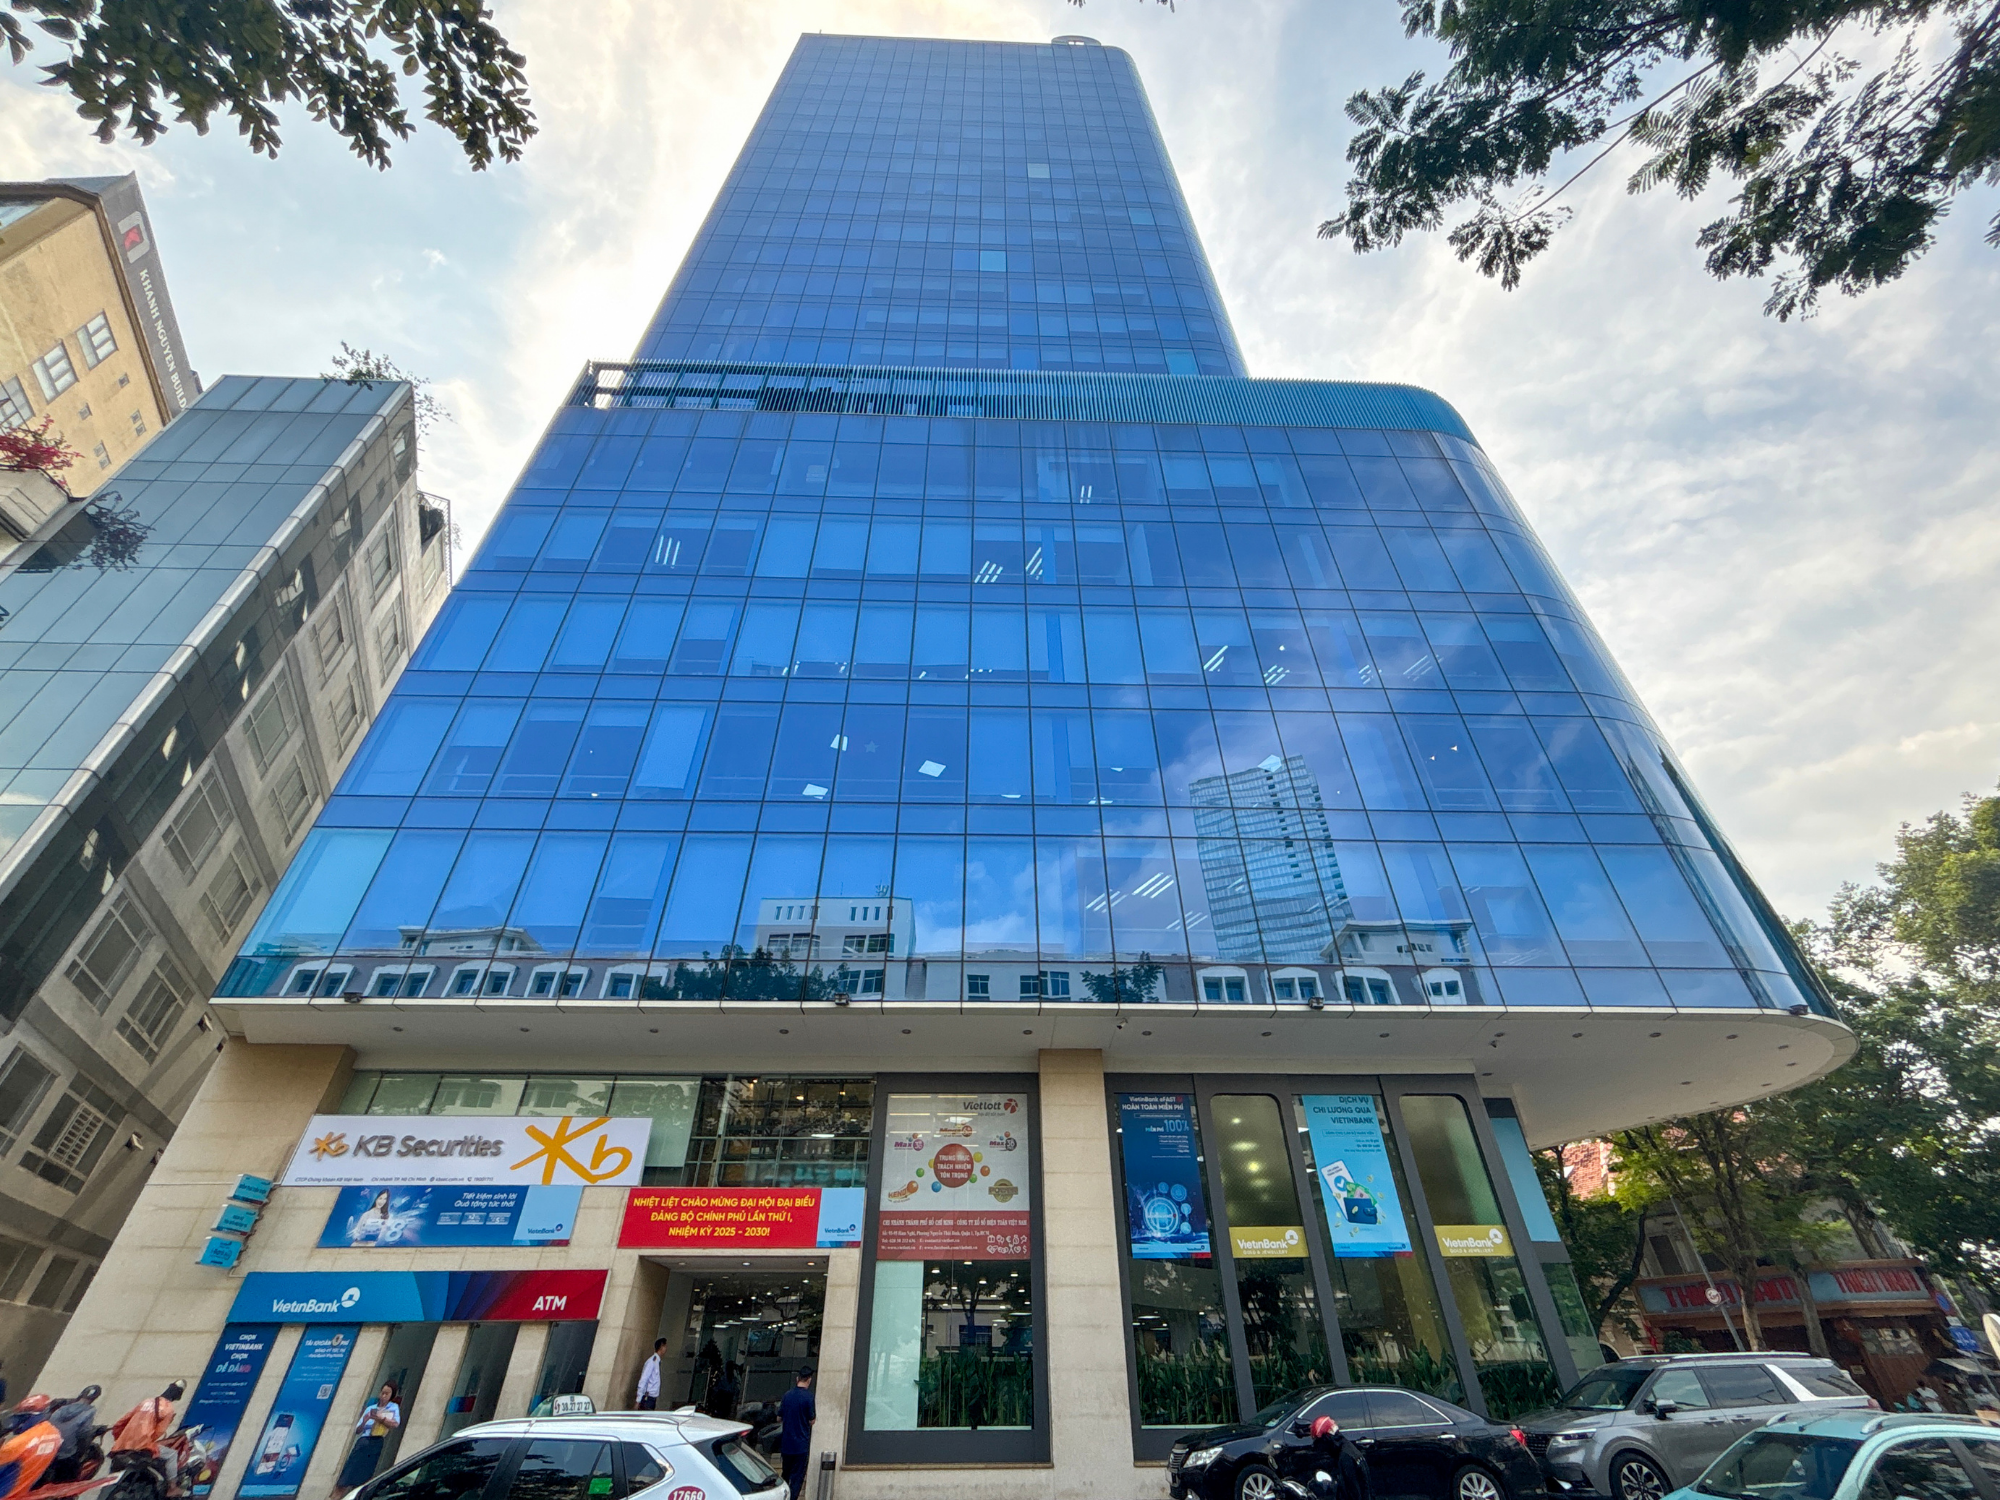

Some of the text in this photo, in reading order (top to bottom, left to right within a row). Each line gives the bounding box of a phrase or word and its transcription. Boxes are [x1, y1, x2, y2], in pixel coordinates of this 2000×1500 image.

[139, 268, 188, 411] KHANH NGUYEN BUILD
[963, 1101, 1002, 1111] Vietlott
[1339, 1096, 1370, 1105] DỊCH VỤ
[1328, 1106, 1353, 1114] LƯƠNG
[1355, 1106, 1371, 1114] QUA
[1164, 1119, 1189, 1132] 100%
[353, 1134, 504, 1157] KB Securities
[633, 1195, 815, 1209] NHIỆT LIỆT CHÀO MỪNG ĐẠI HỘI ĐẠI BIỂU
[651, 1212, 678, 1221] ĐẢNG
[680, 1212, 694, 1222] BỘ
[695, 1211, 725, 1221] CHÍNH
[727, 1211, 746, 1221] PHỦ
[747, 1211, 765, 1221] LẦN
[767, 1211, 786, 1221] THỨ
[668, 1227, 698, 1239] NHIỆM
[699, 1226, 713, 1236] KỲ
[713, 1227, 736, 1237] 2025
[744, 1227, 771, 1237] 2030!
[1237, 1239, 1288, 1249] VietinBank
[1442, 1238, 1494, 1247] VietinBank
[272, 1298, 340, 1313] VietinBank
[532, 1296, 567, 1311] ATM
[576, 1402, 583, 1411] 27
[584, 1401, 591, 1411] 27
[673, 1490, 703, 1500] 17669
